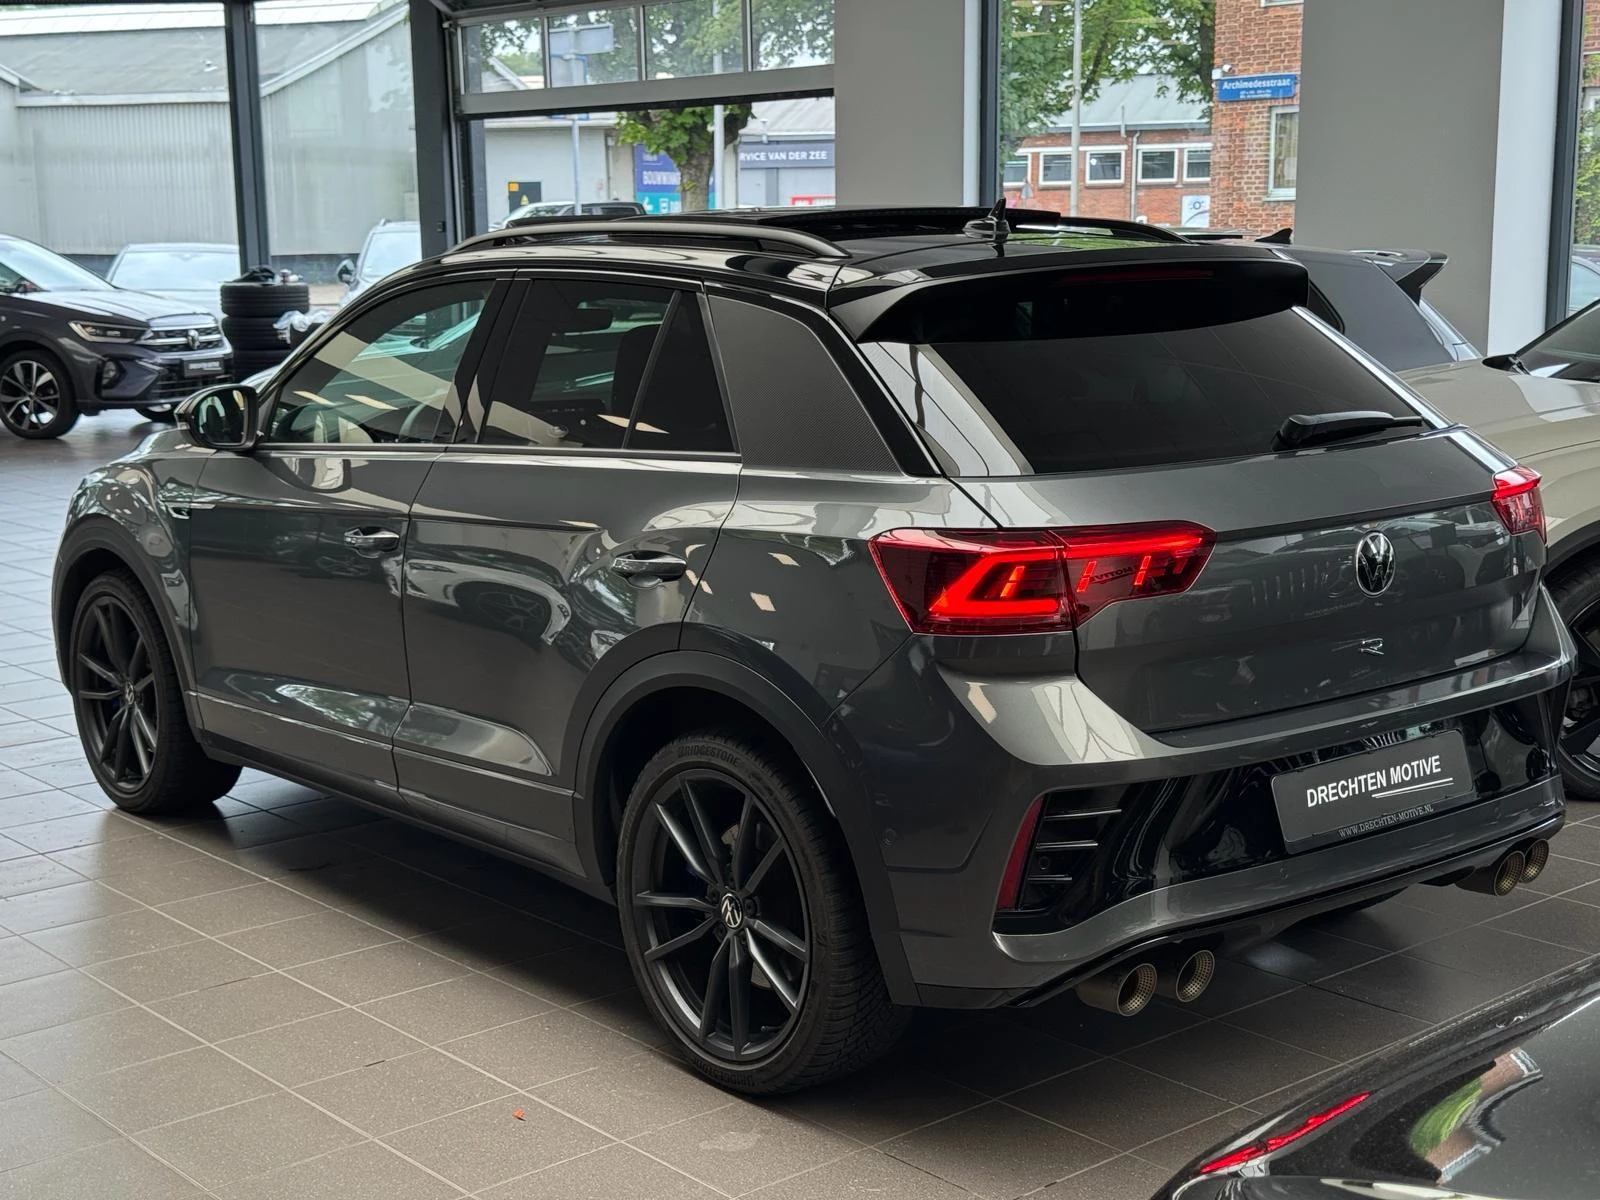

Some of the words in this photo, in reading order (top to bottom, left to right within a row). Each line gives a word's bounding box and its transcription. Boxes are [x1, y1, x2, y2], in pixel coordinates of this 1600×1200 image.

[1222, 78, 1291, 90] Archimedesstraat
[768, 151, 787, 160] VAN
[788, 151, 807, 160] DER
[809, 150, 828, 160] ZEE
[1306, 769, 1387, 808] DRECHTEN
[1390, 755, 1442, 785] MOTIVE
[1338, 804, 1434, 839] WWW.DRECHTEN-MOTIVE.NL
